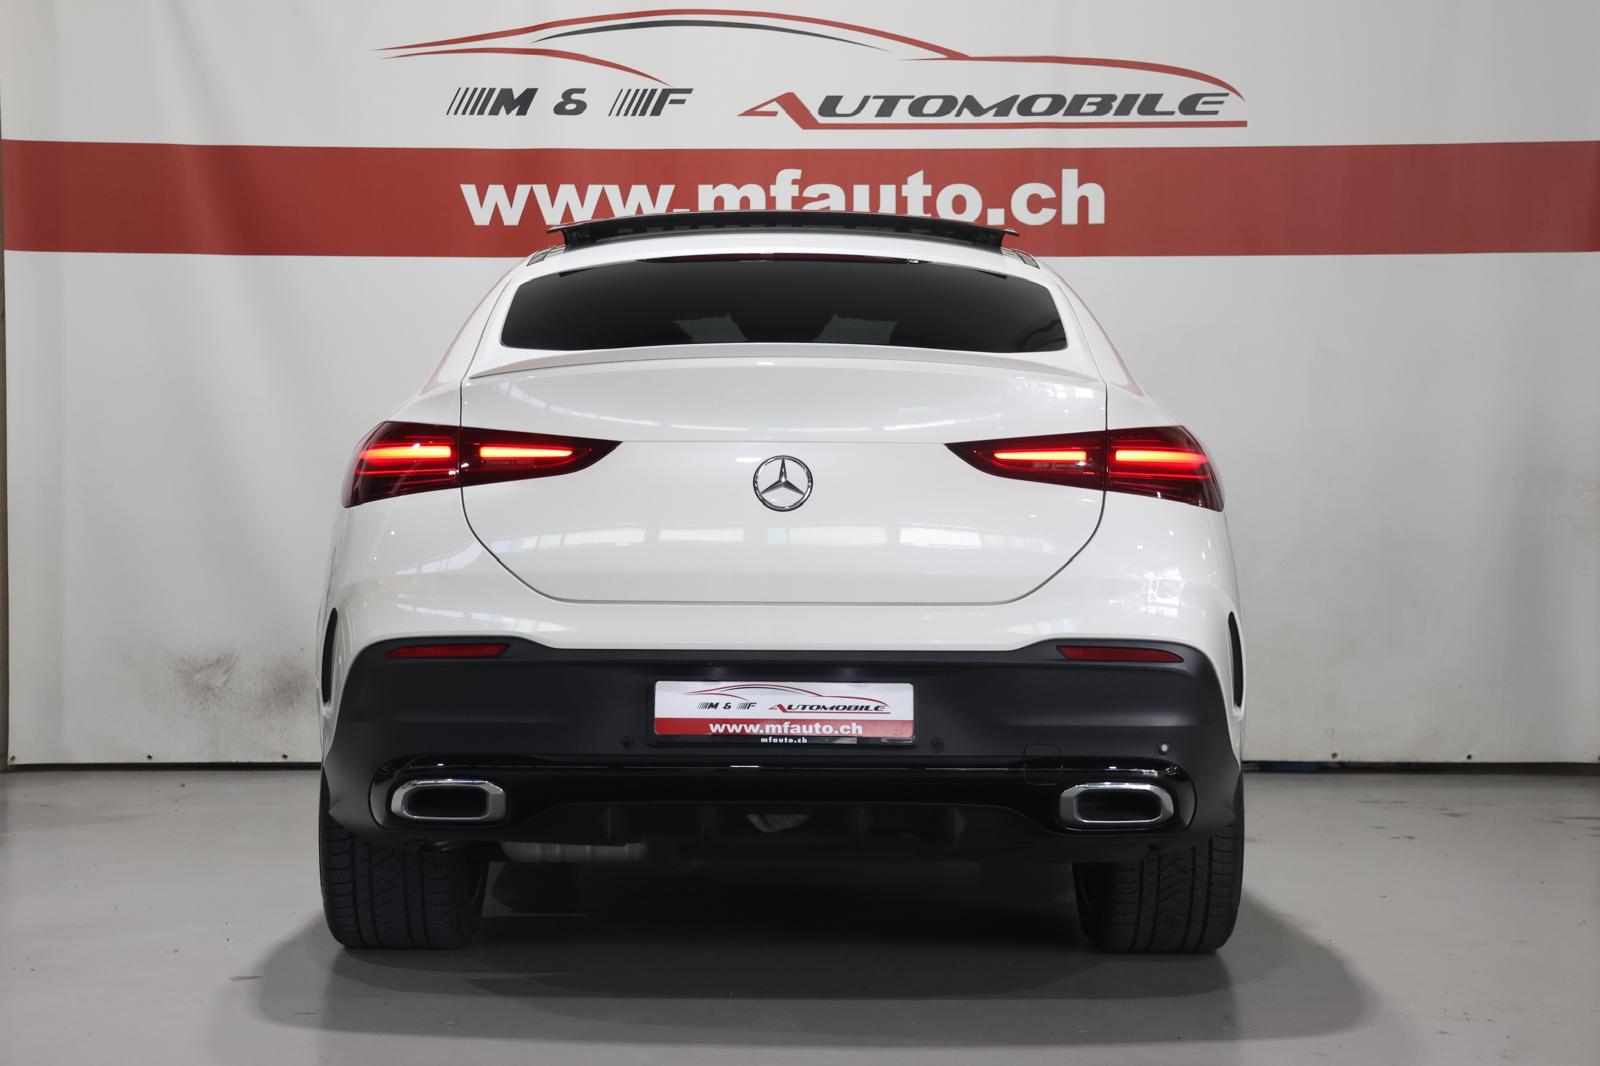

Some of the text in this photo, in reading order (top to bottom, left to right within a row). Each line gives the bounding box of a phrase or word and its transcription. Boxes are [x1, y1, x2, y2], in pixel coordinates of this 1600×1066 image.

[553, 87, 587, 116] &
[738, 92, 1230, 129] AUTOMOBILE
[460, 168, 1106, 226] wwwmfauto.ch
[723, 702, 732, 710] &
[708, 721, 863, 734] www.mfauto.ch
[760, 736, 808, 744] mfauto.ch
